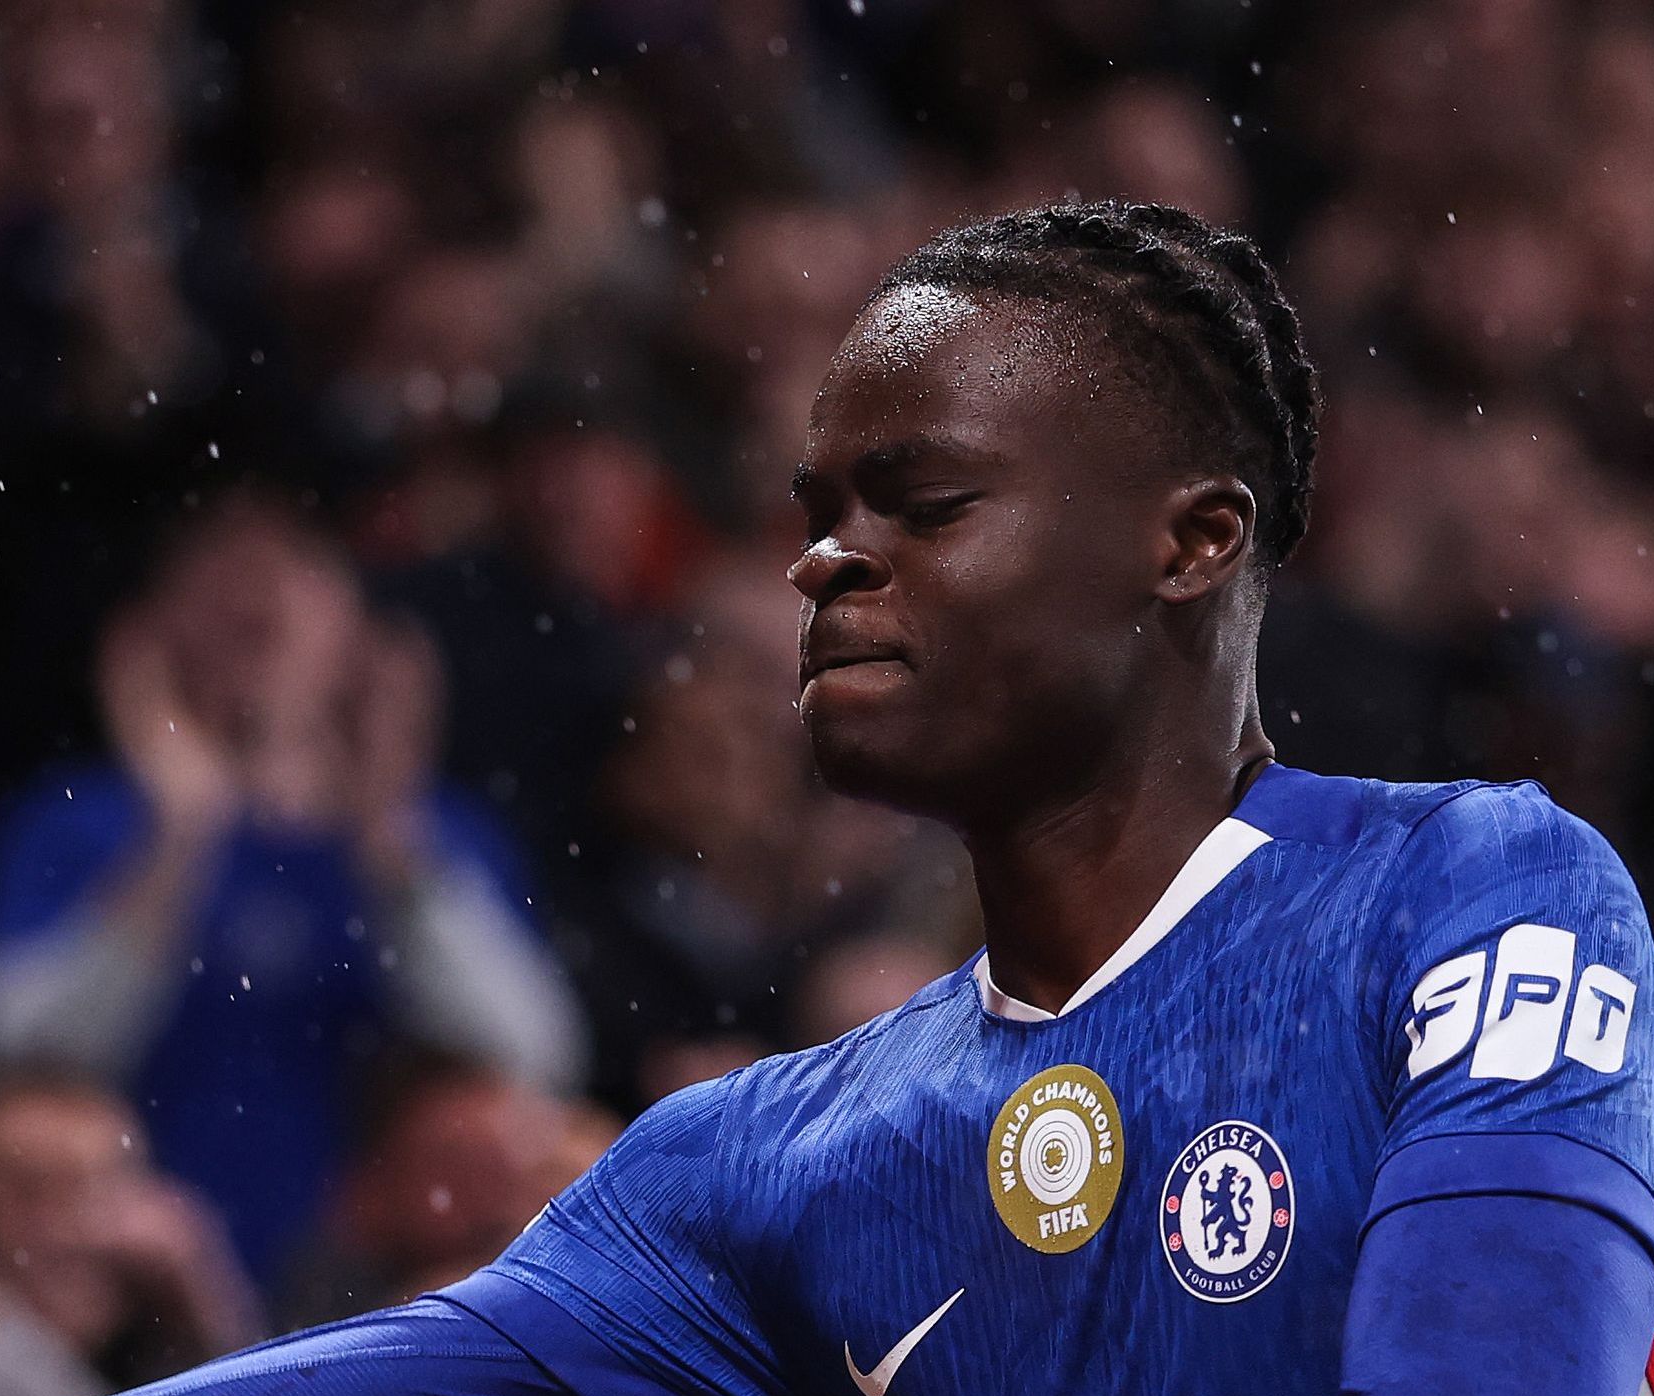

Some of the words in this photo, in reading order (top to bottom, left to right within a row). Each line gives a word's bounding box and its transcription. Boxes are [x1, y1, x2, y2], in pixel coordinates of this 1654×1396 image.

[999, 1103, 1030, 1193] WORLD
[1032, 1080, 1115, 1166] CHAMPIONS
[1181, 1127, 1264, 1174] CHELSEA
[1037, 1203, 1089, 1240] FIFA
[1185, 1267, 1246, 1293] FOOTBALL
[1248, 1249, 1277, 1282] CLUB
